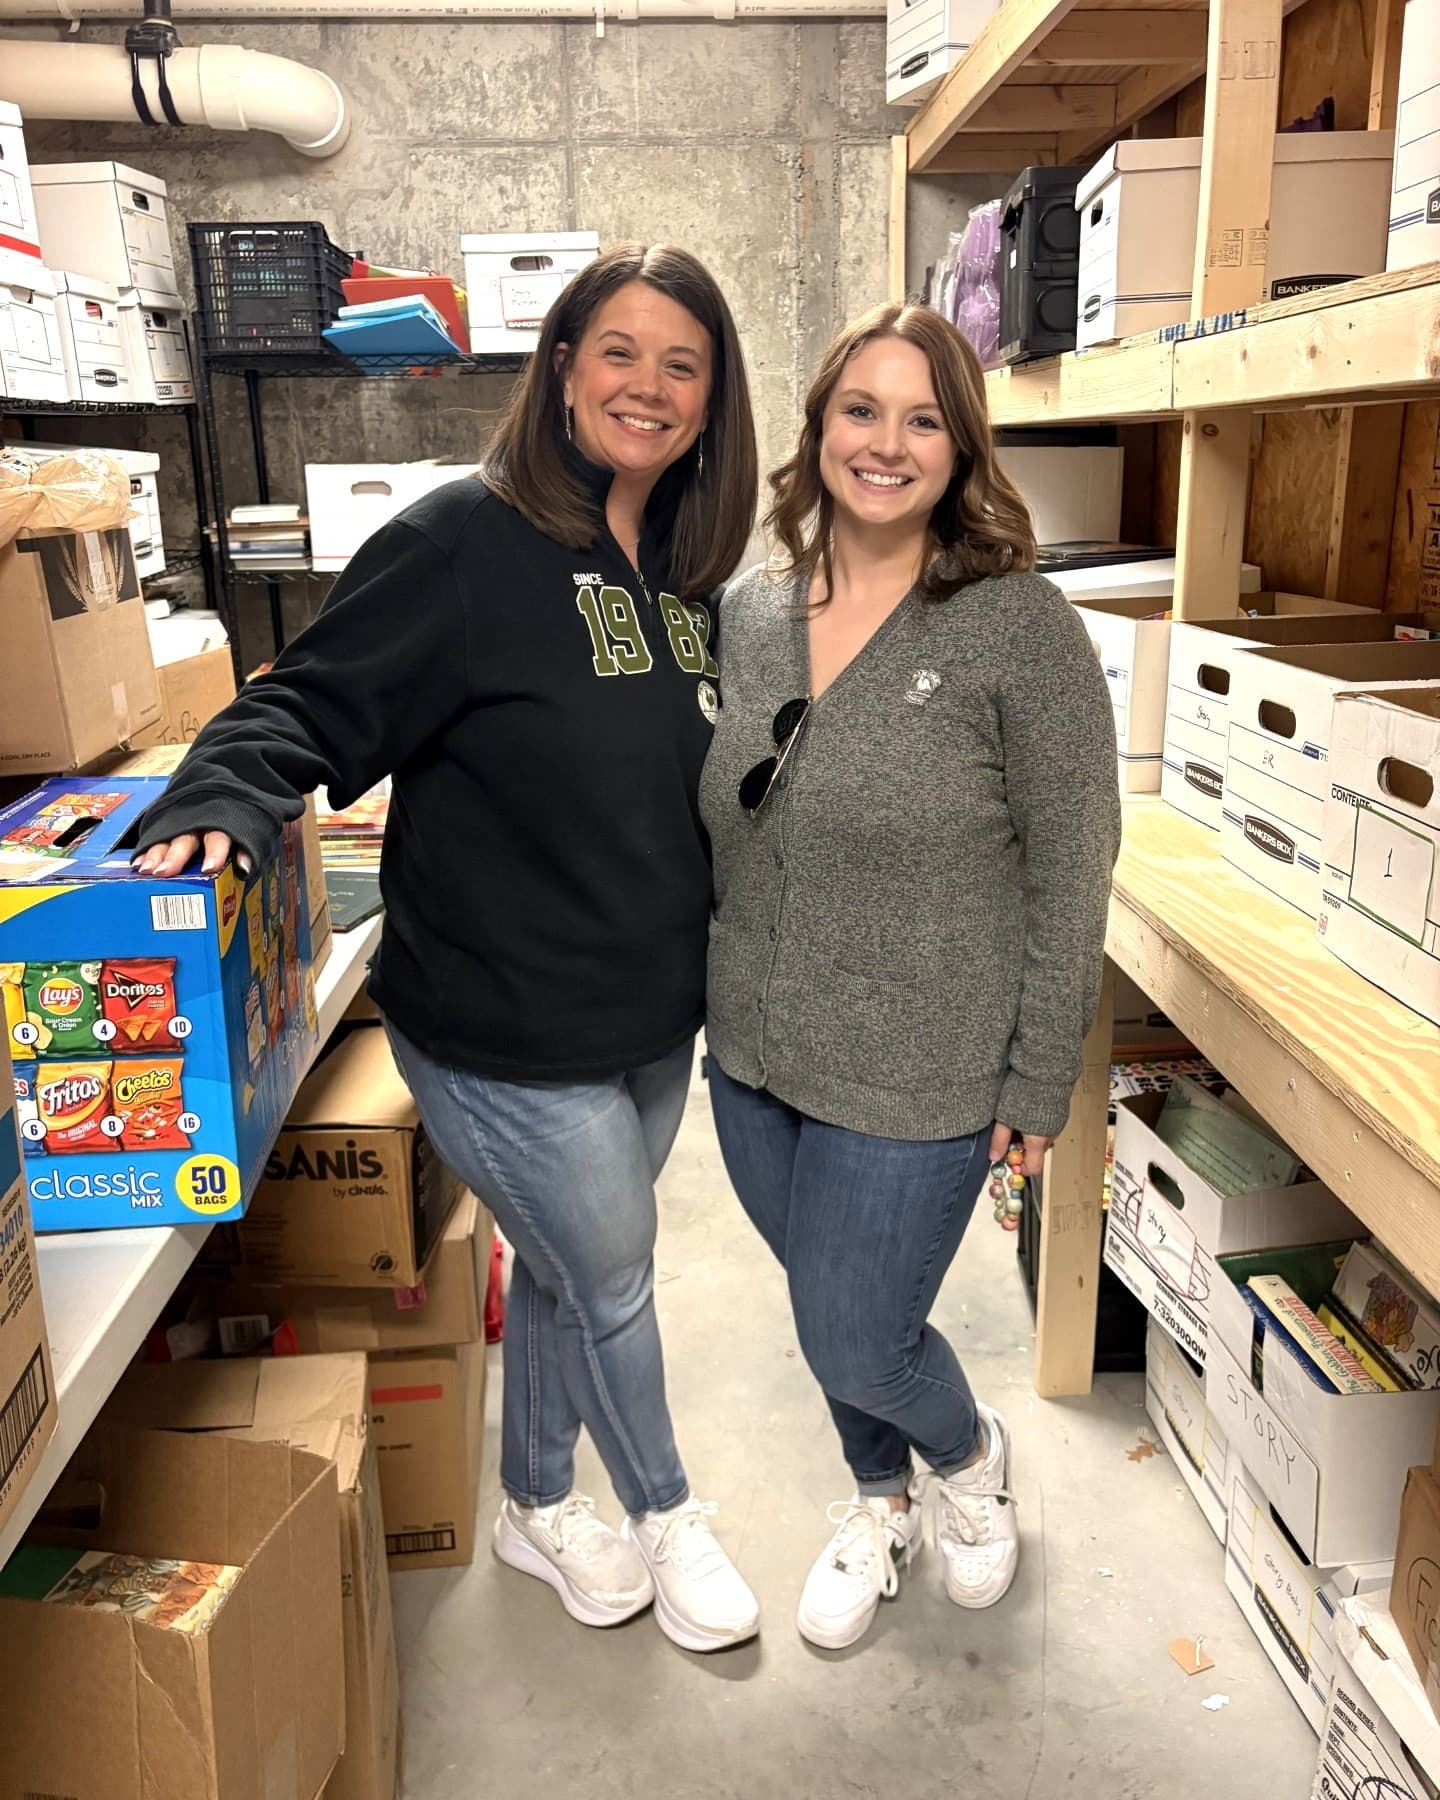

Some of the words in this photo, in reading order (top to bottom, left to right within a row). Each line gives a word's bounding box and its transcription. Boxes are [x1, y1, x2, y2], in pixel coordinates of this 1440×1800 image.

[1277, 284, 1328, 294] BANKE
[573, 573, 604, 585] SINCE
[576, 586, 653, 676] 19
[1187, 768, 1214, 789] BANKERS
[1214, 780, 1223, 790] BO
[1246, 823, 1277, 848] BANKERS
[1277, 839, 1292, 856] BOX
[1384, 848, 1392, 877] 1
[107, 983, 165, 998] Doritos
[22, 1028, 30, 1039] 6
[100, 1024, 108, 1036] 4
[174, 1021, 186, 1029] 10
[116, 1071, 171, 1101] Cheetos
[40, 1077, 101, 1116] Fritos
[30, 1125, 38, 1135] 6
[68, 1120, 98, 1138] ORIGINAL
[109, 1121, 116, 1132] 8
[184, 1118, 195, 1129] 16
[31, 1166, 161, 1200] classic
[191, 1166, 226, 1195] 50
[131, 1195, 163, 1208] MIX
[195, 1195, 227, 1205] BAGS
[333, 1186, 346, 1199] by
[1147, 1209, 1166, 1244] Story
[1177, 1301, 1198, 1329] STORAGE
[1318, 1347, 1350, 1380] Golden
[1227, 1374, 1295, 1485] STORY
